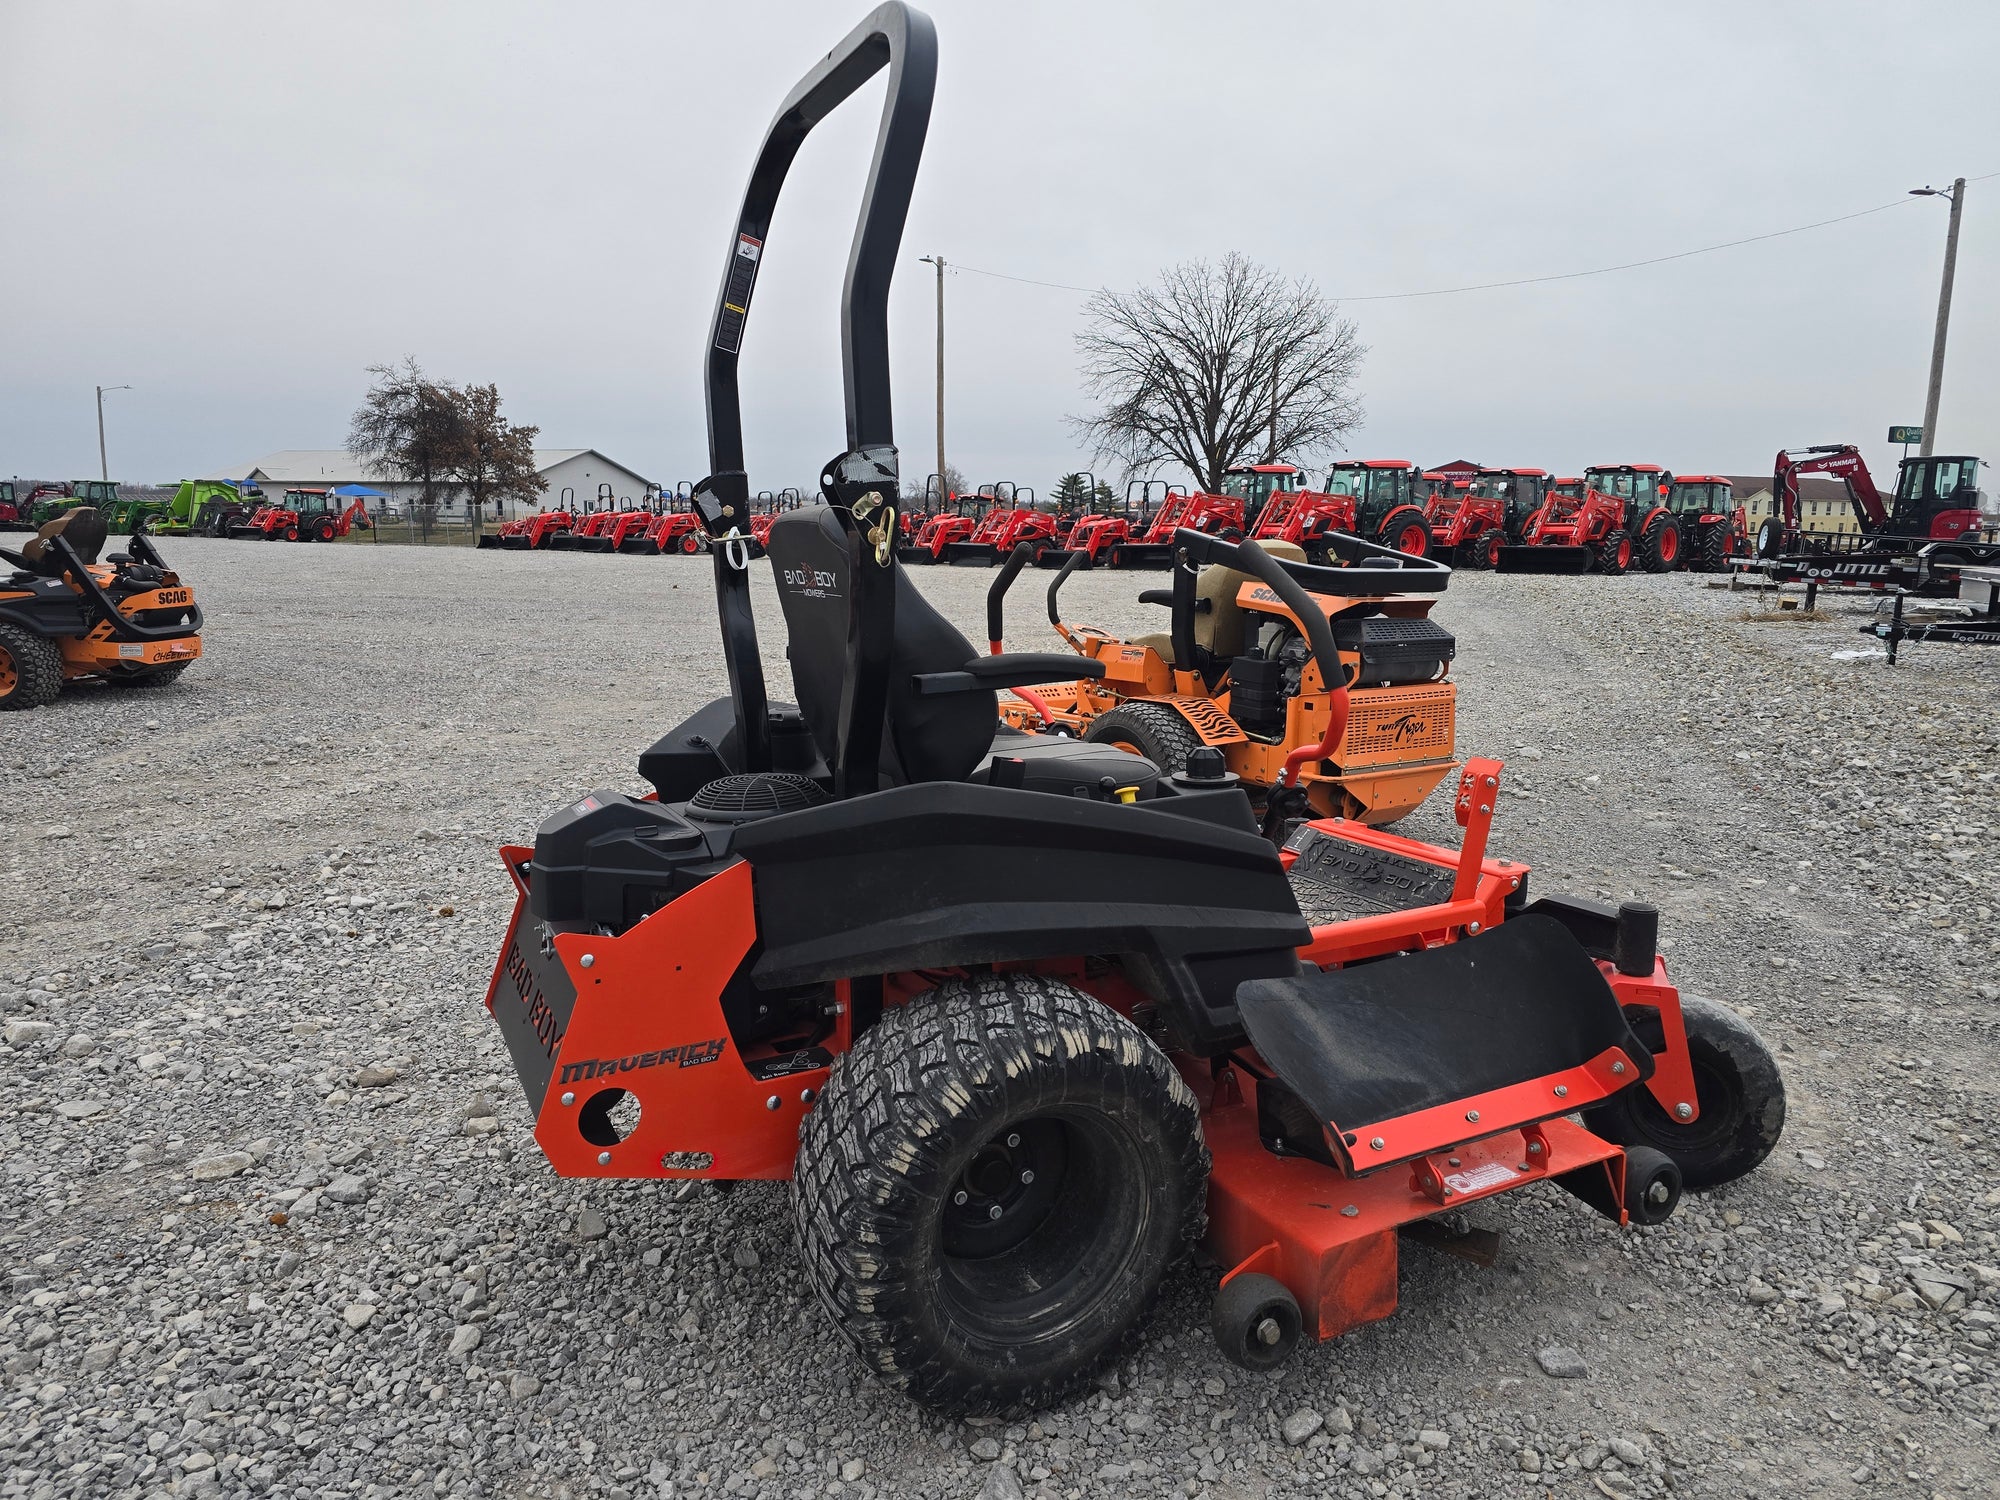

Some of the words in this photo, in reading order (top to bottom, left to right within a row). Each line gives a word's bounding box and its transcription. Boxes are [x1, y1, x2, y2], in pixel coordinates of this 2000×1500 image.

[1829, 458, 1857, 467] YANMAR
[784, 570, 806, 584] BAD
[814, 571, 836, 588] BOY
[158, 590, 187, 604] SCAG
[803, 589, 826, 598] MOWERS
[1395, 714, 1426, 743] Tiger
[507, 941, 533, 1003] BAD
[528, 988, 564, 1060] BOY
[559, 1037, 728, 1084] MAVERICK
[682, 1058, 700, 1067] BAD
[700, 1054, 718, 1064] BOY
